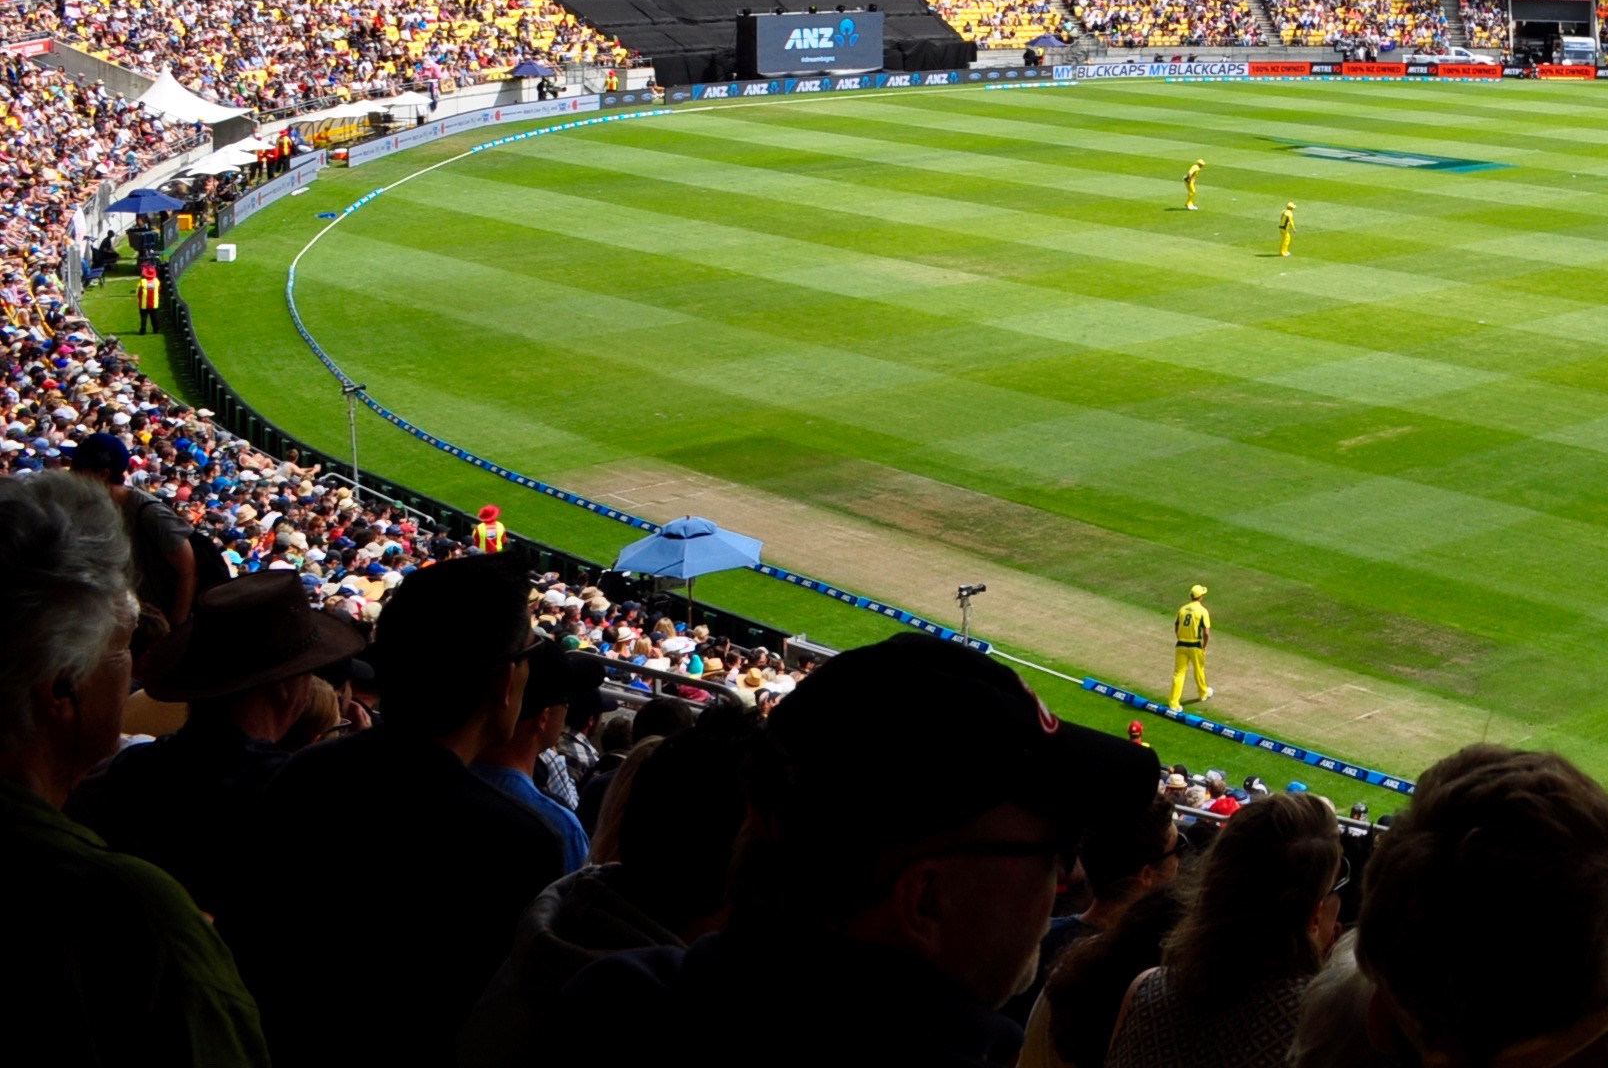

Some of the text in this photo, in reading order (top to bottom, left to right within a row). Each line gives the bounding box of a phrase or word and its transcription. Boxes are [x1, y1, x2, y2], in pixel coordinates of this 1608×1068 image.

[784, 27, 834, 50] ANZ
[924, 73, 949, 85] ANZ
[1055, 66, 1073, 79] MY
[796, 80, 820, 93] ANZ
[836, 77, 860, 90] ANZ
[887, 75, 911, 87] ANZ
[703, 85, 728, 99] ANZ
[744, 83, 768, 96] ANZ
[1184, 613, 1192, 627] 8
